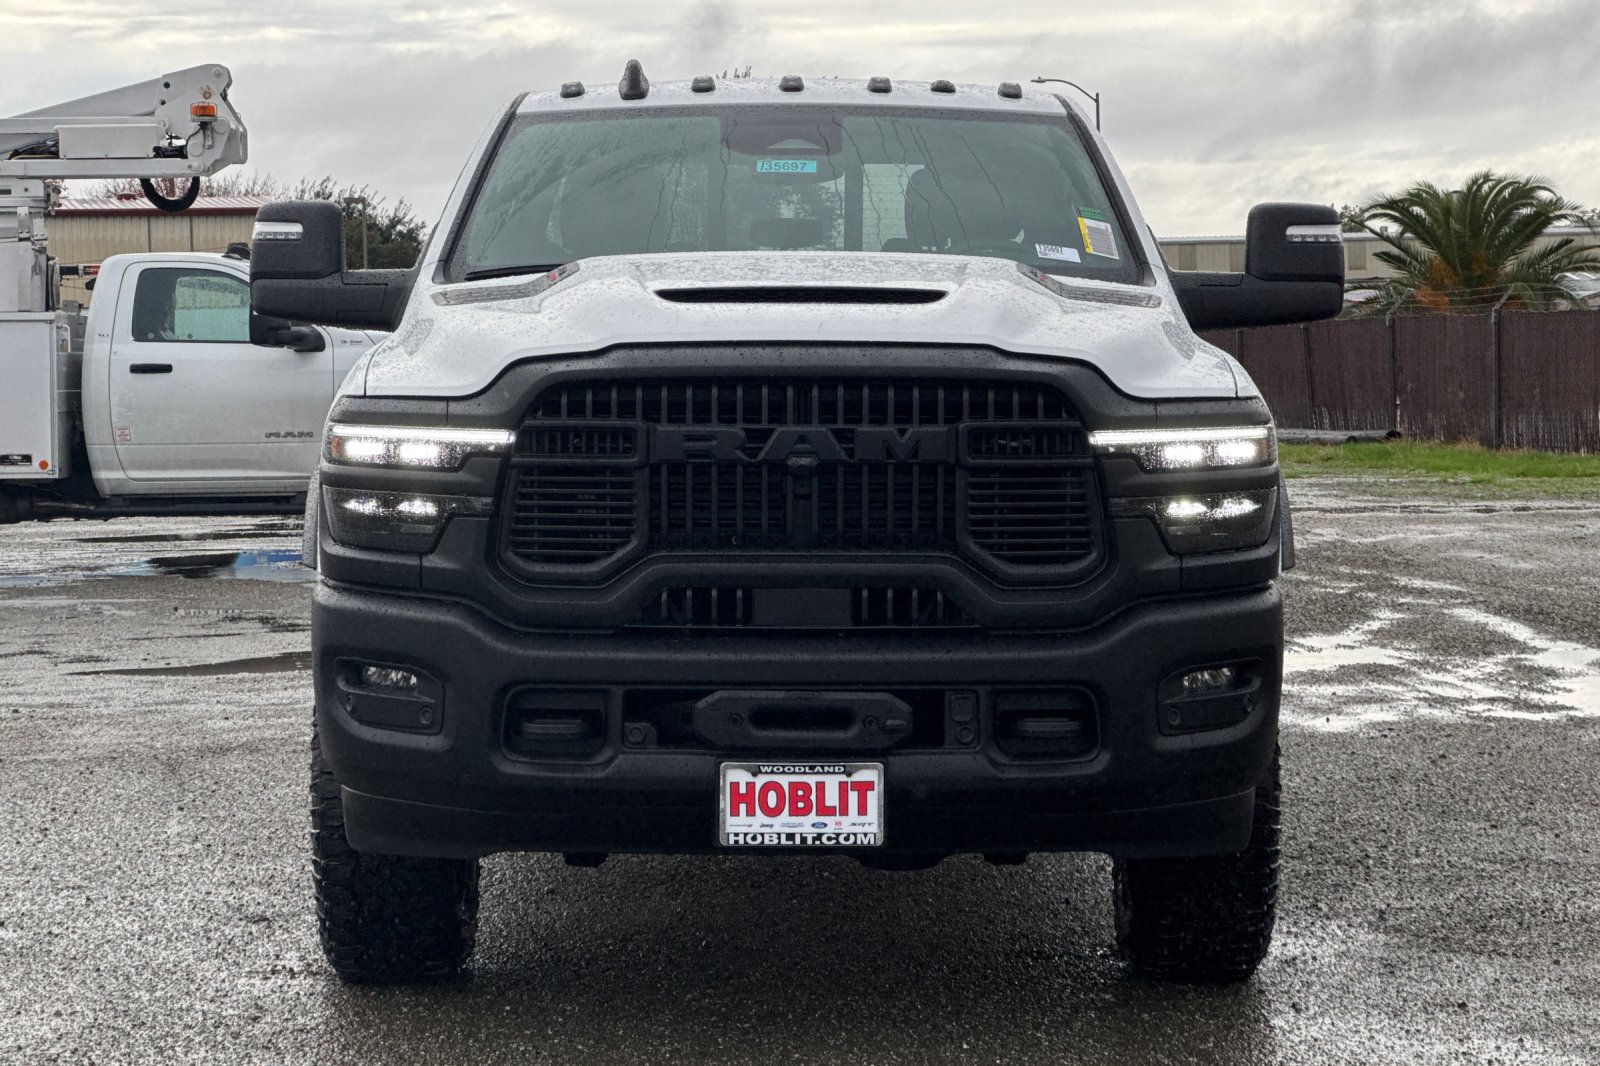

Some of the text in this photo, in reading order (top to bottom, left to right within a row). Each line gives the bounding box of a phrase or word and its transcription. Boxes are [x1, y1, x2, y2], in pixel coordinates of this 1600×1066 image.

[653, 425, 949, 462] RAM
[759, 765, 845, 773] WOODLAND
[729, 781, 875, 817] HOBLIT
[728, 833, 875, 845] HOBLIT.COM
